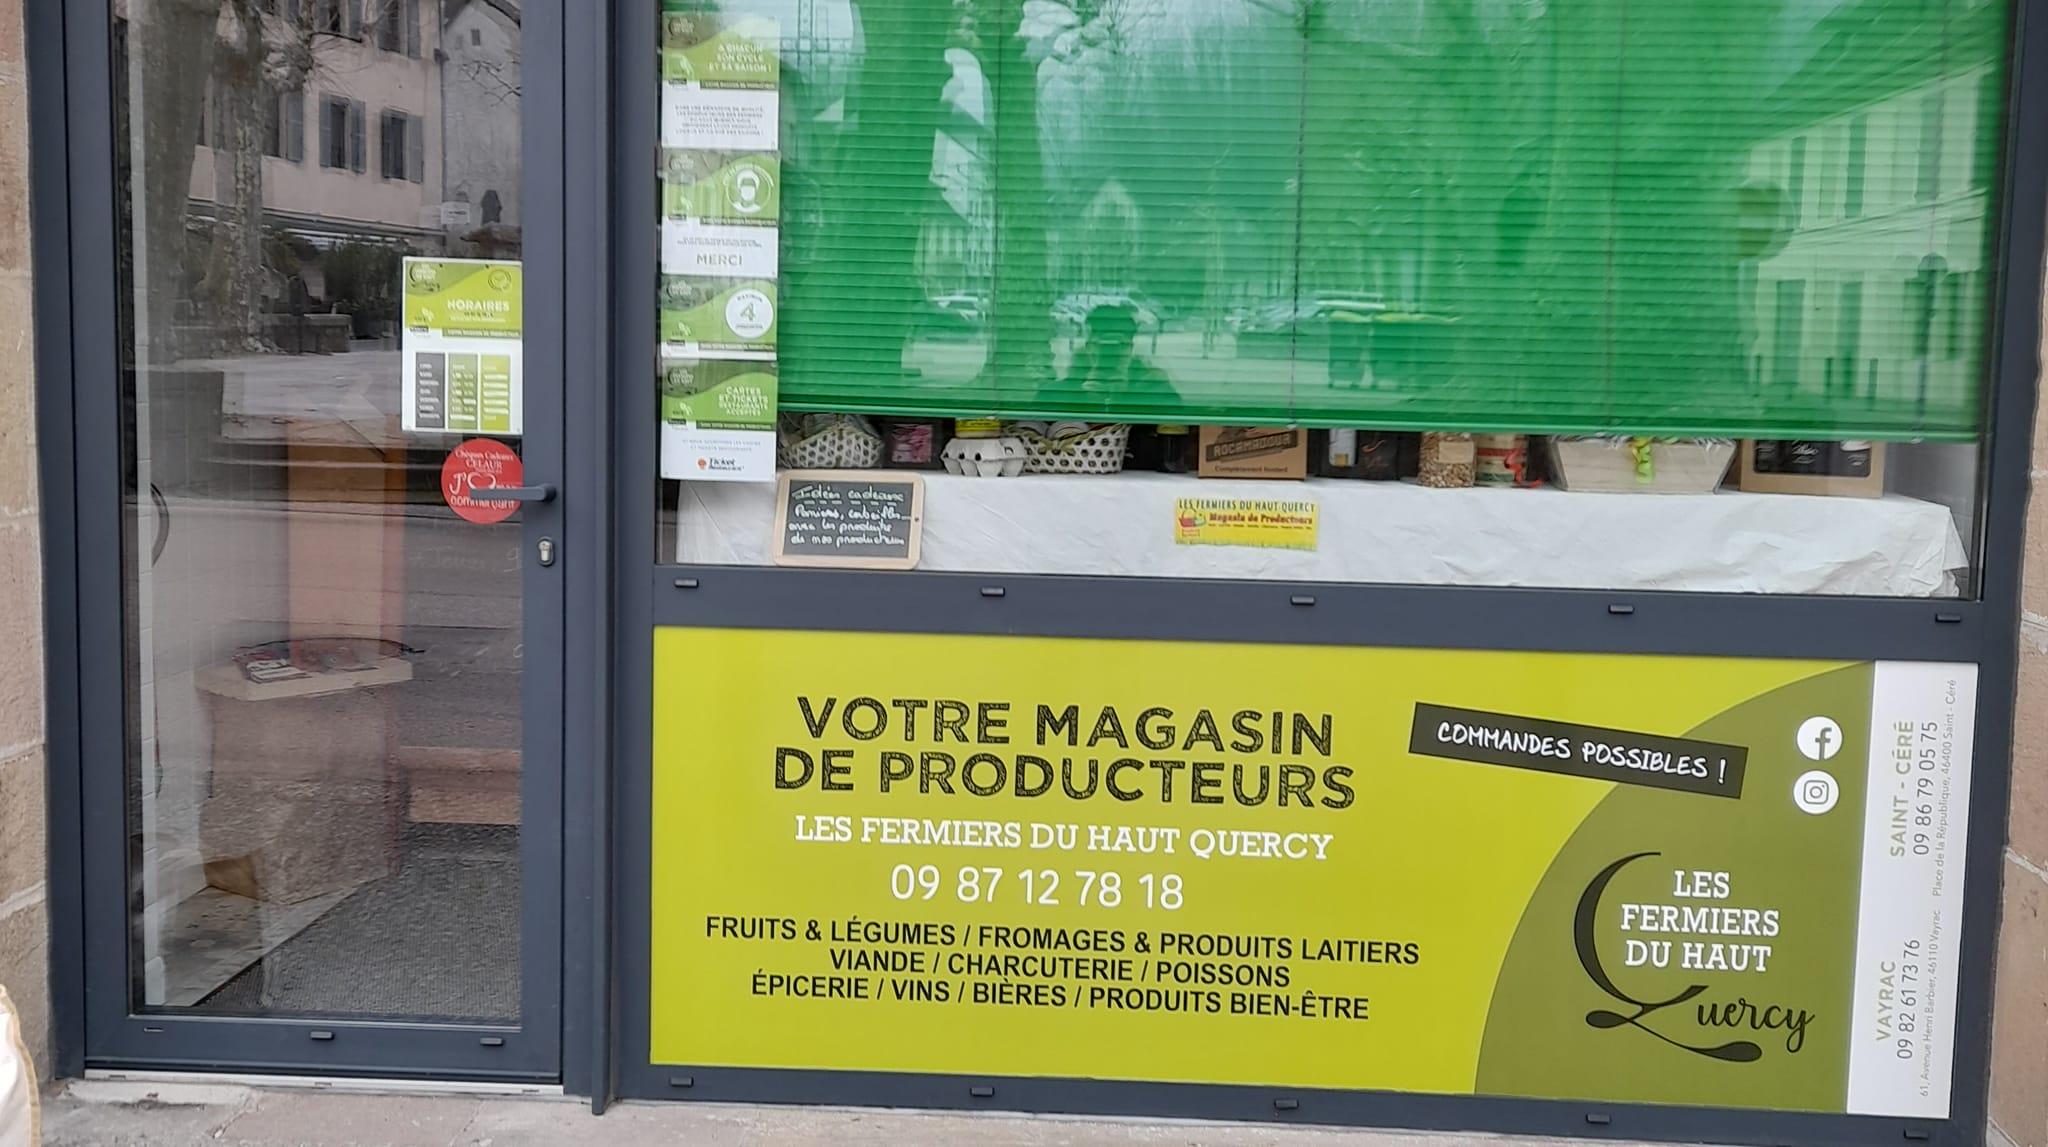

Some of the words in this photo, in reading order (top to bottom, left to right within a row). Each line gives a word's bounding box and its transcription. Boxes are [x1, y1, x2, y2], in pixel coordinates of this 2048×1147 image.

[736, 63, 766, 73] SAISON
[737, 54, 763, 63] CYCLE
[697, 254, 742, 266] MERCI
[447, 300, 509, 312] HORAIRES
[740, 302, 755, 321] 4
[726, 386, 761, 396] CARTES
[1214, 434, 1290, 457] ROCAMADOUR
[1179, 499, 1193, 509] LES
[1196, 500, 1236, 511] FERMIERS
[1240, 501, 1251, 511] DU
[1255, 501, 1278, 511] HAUT
[1282, 502, 1315, 512] QUERCY
[1209, 513, 1245, 523] Magasin
[1248, 513, 1258, 522] de
[1261, 514, 1312, 525] Producteurs
[1945, 680, 1957, 705] Céré
[797, 696, 1011, 745] VOTRE
[1036, 704, 1332, 756] MAGASIN
[1920, 721, 1938, 743] 75
[1943, 713, 1954, 738] Saint
[1437, 721, 1571, 758] COMMANDES
[1582, 742, 1708, 778] POSSIBLES
[1717, 759, 1727, 784] !
[1892, 720, 1914, 775] CÉRÉ
[1919, 748, 1936, 771] 05
[1941, 741, 1953, 775] 46400
[775, 747, 854, 791] DE
[880, 751, 1355, 809] PRODUCTEURS
[1917, 777, 1934, 798] 79
[1915, 804, 1932, 826] 86
[1936, 776, 1951, 838] République,
[795, 815, 852, 842] LES
[861, 817, 1021, 848] FERMIERS
[1030, 822, 1079, 850] DU
[1087, 825, 1180, 854] HAUT
[1189, 829, 1334, 860] QUERCY
[1890, 796, 1909, 857] SAINT
[1913, 834, 1930, 855] 09
[1935, 841, 1946, 851] la
[1934, 853, 1945, 867] de
[891, 863, 940, 900] 09
[956, 866, 1003, 903] 87
[1017, 868, 1060, 905] 12
[1074, 870, 1122, 908] 78
[1138, 873, 1183, 910] 18
[1673, 870, 1730, 898] LES
[1932, 872, 1944, 896] Place
[1620, 903, 1779, 937] FERMIERS
[1929, 909, 1943, 942] Vayrac
[706, 916, 797, 940] FRUITS
[805, 919, 822, 941] &
[831, 915, 955, 946] LÉGUMES
[963, 925, 971, 946] /
[978, 926, 1125, 952] FROMAGES
[1134, 931, 1151, 953] &
[1160, 932, 1292, 959] PRODUITS
[1302, 938, 1420, 965] LAITIERS
[1904, 939, 1920, 958] 76
[829, 948, 925, 972] VIANDE
[933, 952, 940, 974] /
[947, 953, 1132, 981] CHARCUTERIE
[1141, 960, 1148, 982] /
[1156, 961, 1290, 987] POISSONS
[1625, 940, 1672, 968] DU
[1681, 942, 1772, 972] HAUT
[1927, 943, 1938, 976] 46110
[1902, 964, 1918, 983] 73
[751, 968, 869, 999] ÉPICERIE
[876, 978, 884, 1000] /
[892, 979, 950, 1002] VINS
[957, 981, 965, 1003] /
[973, 977, 1067, 1007] BIÈRES
[1074, 985, 1082, 1008] /
[1090, 986, 1221, 1013] PRODUITS
[1230, 990, 1369, 1019] BIEN-ÊTRE
[1876, 961, 1896, 1041] VAYRAC
[1900, 988, 1917, 1007] 61
[1924, 977, 1937, 1014] Barbier,
[1898, 1012, 1915, 1033] 82
[1922, 1014, 1934, 1042] Henri
[1897, 1038, 1913, 1060] 09
[1920, 1046, 1932, 1081] Avenue
[1919, 1082, 1930, 1097] 61,
